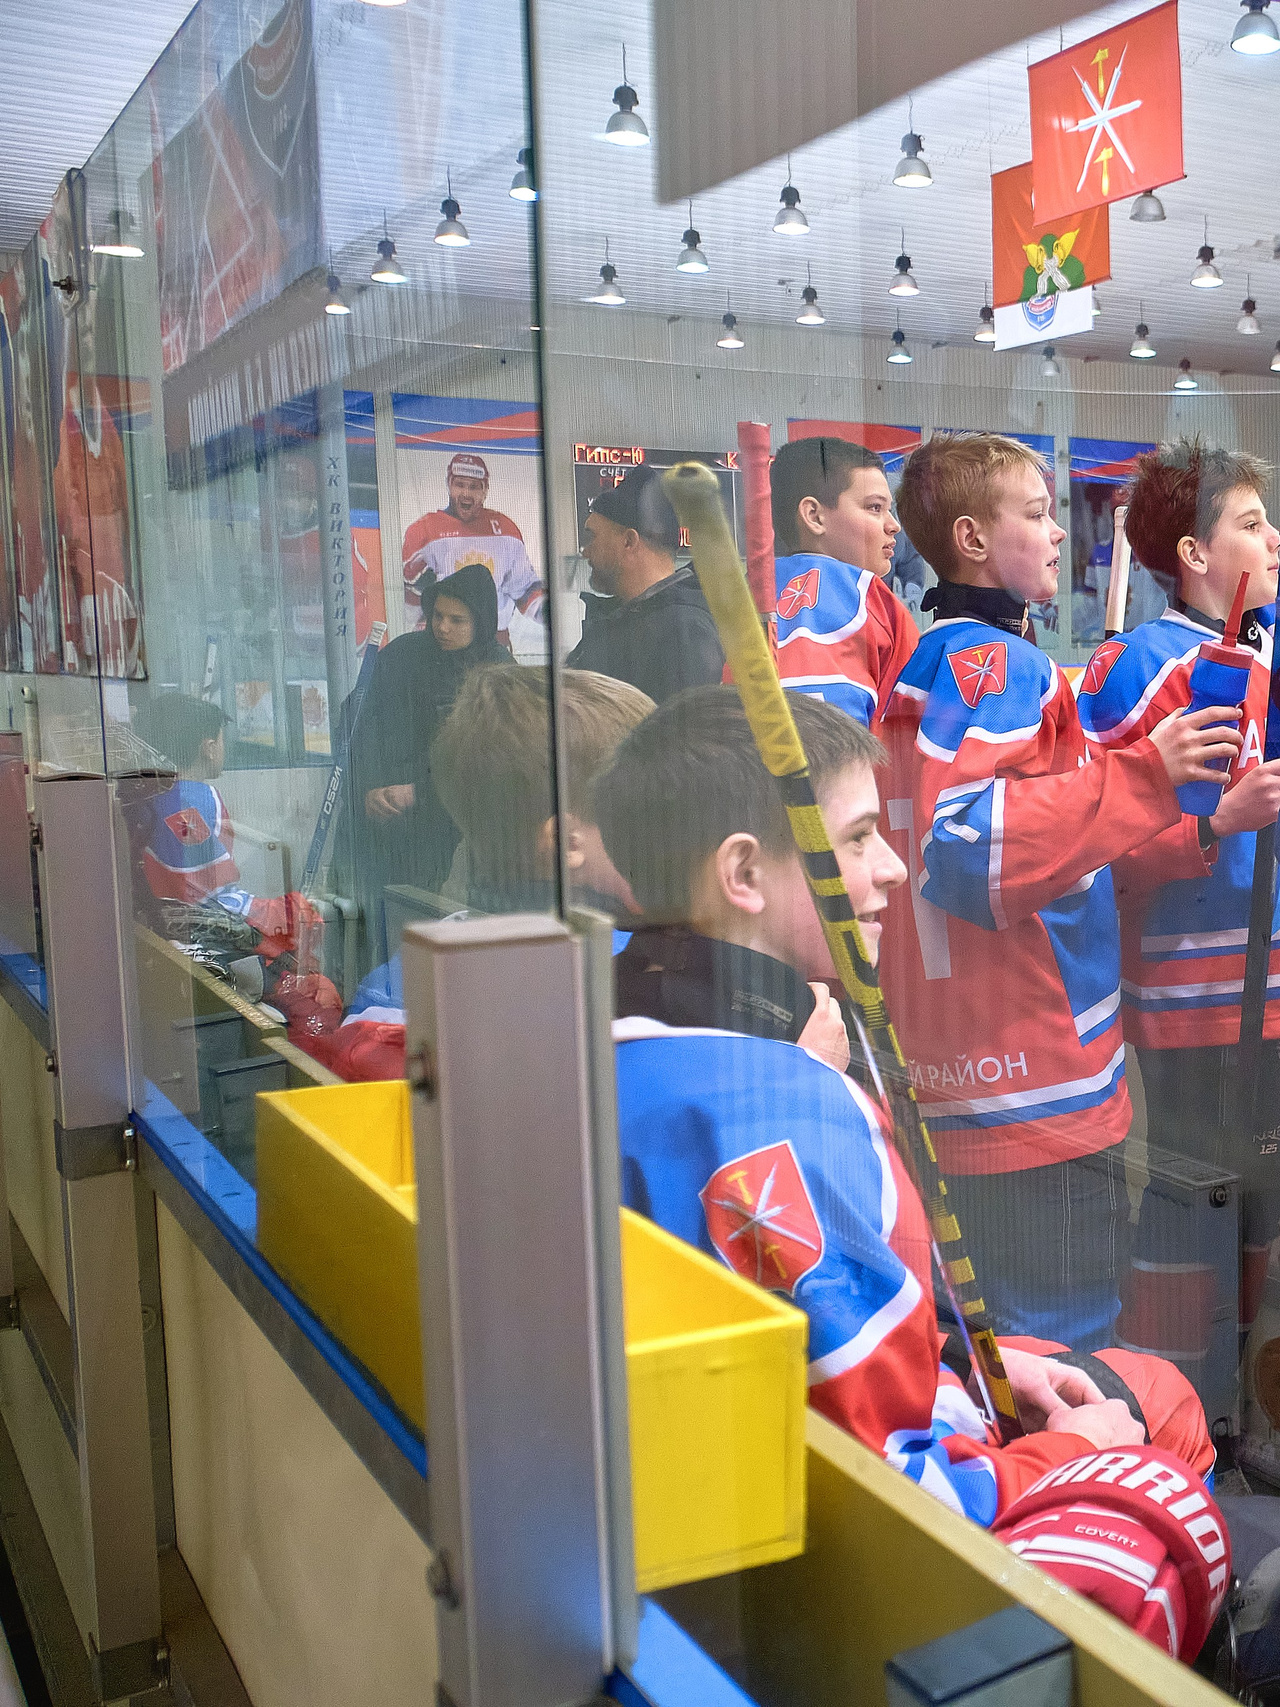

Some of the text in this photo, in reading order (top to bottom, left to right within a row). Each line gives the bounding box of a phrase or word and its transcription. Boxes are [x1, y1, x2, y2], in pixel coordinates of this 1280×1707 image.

[330, 503, 347, 637] ВИКТОРИЯ
[927, 1052, 1029, 1089] РАЙОН
[1259, 1143, 1278, 1155] 125
[1074, 1523, 1140, 1550] COVERT
